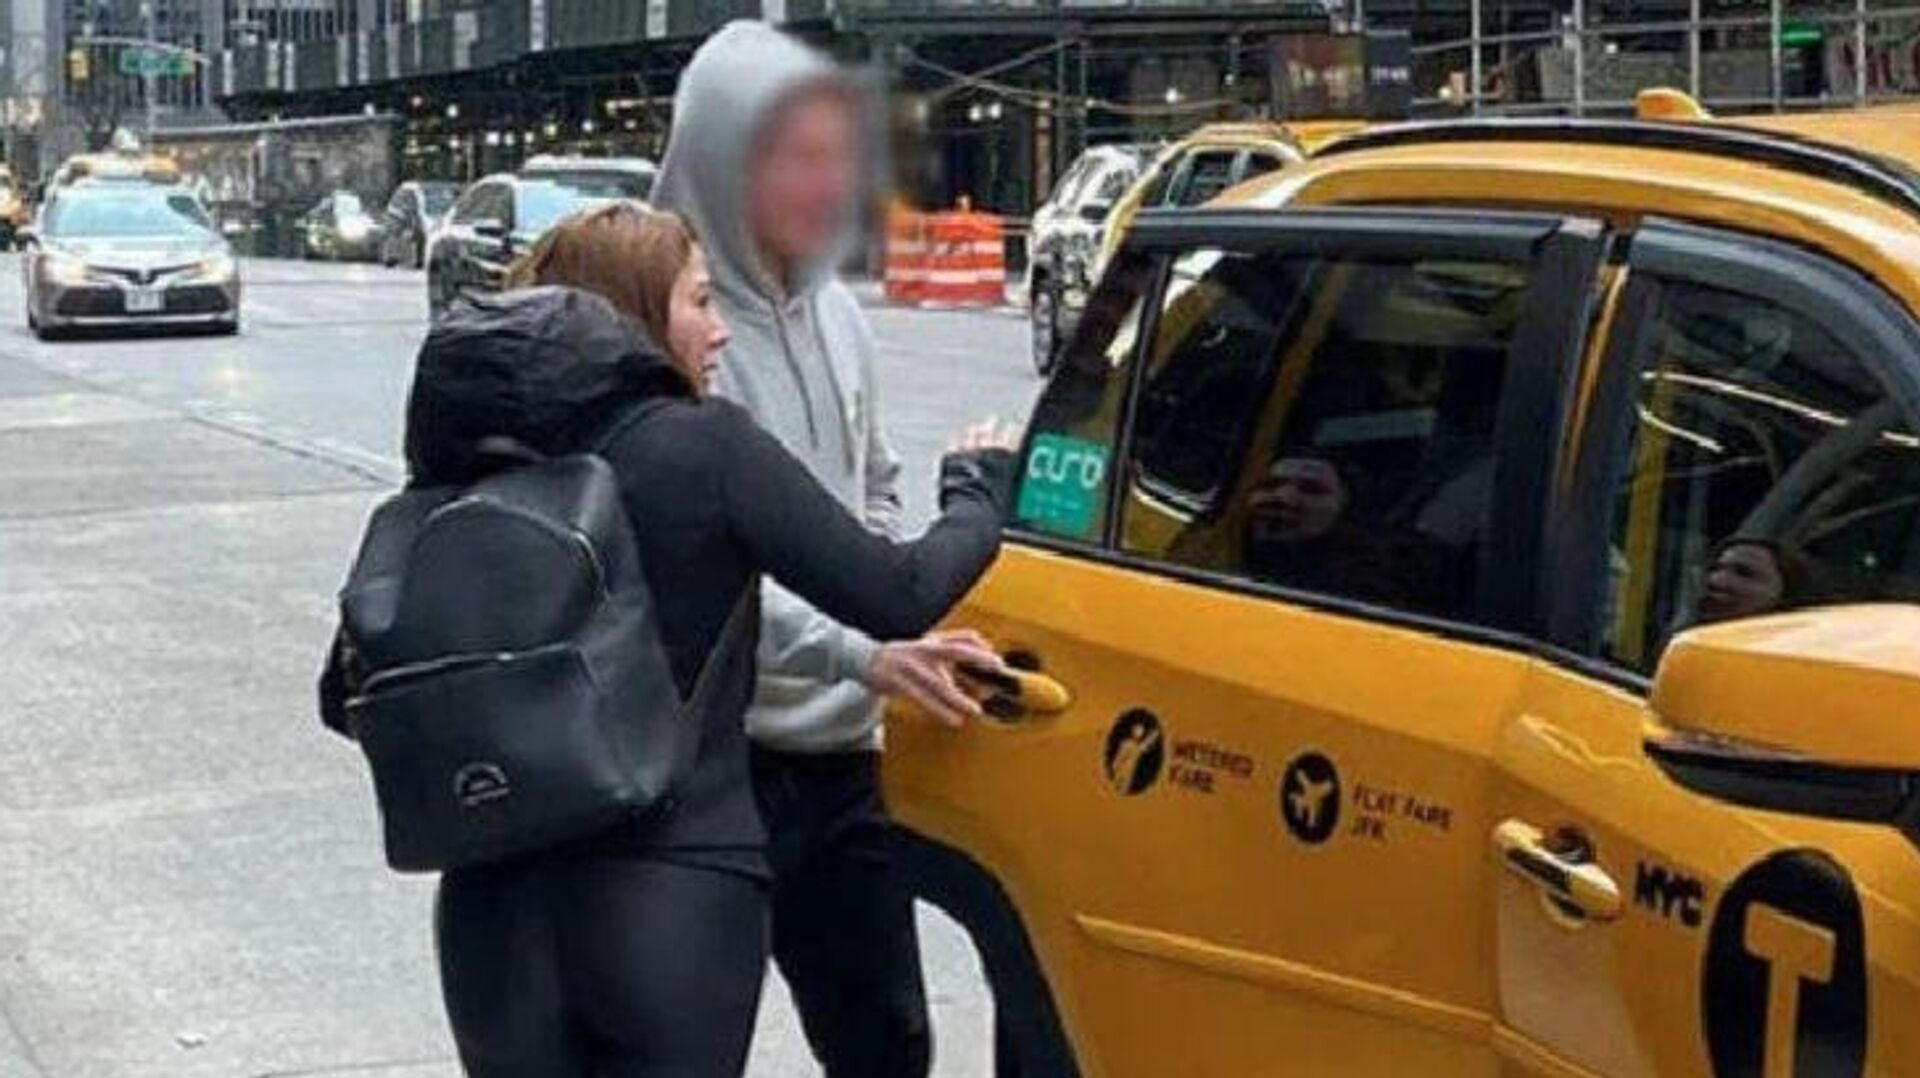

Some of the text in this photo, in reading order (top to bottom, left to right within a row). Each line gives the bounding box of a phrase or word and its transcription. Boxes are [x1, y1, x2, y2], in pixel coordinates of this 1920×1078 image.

[1351, 815, 1387, 842] JFK
[1353, 782, 1453, 831] FLAT FARE
[1635, 860, 1837, 1078] NYC T
